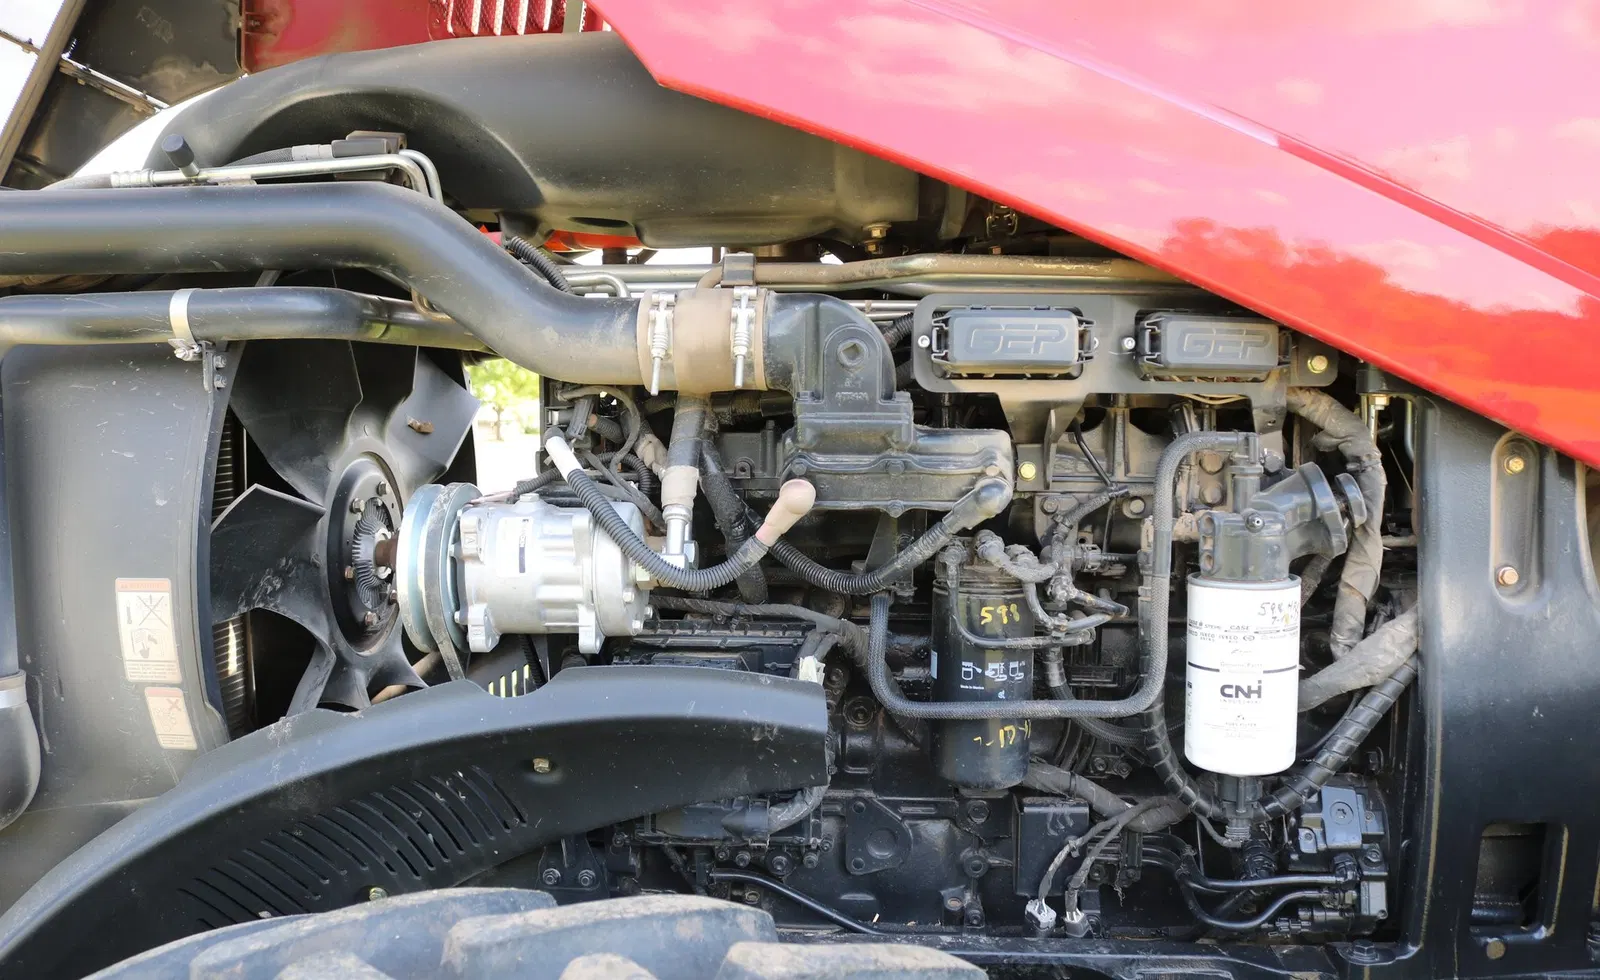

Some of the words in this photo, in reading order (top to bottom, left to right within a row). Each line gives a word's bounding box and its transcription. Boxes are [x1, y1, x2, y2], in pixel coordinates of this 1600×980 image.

[967, 323, 1069, 355] GEP
[1177, 327, 1271, 359] GEP
[981, 603, 1020, 625] 598
